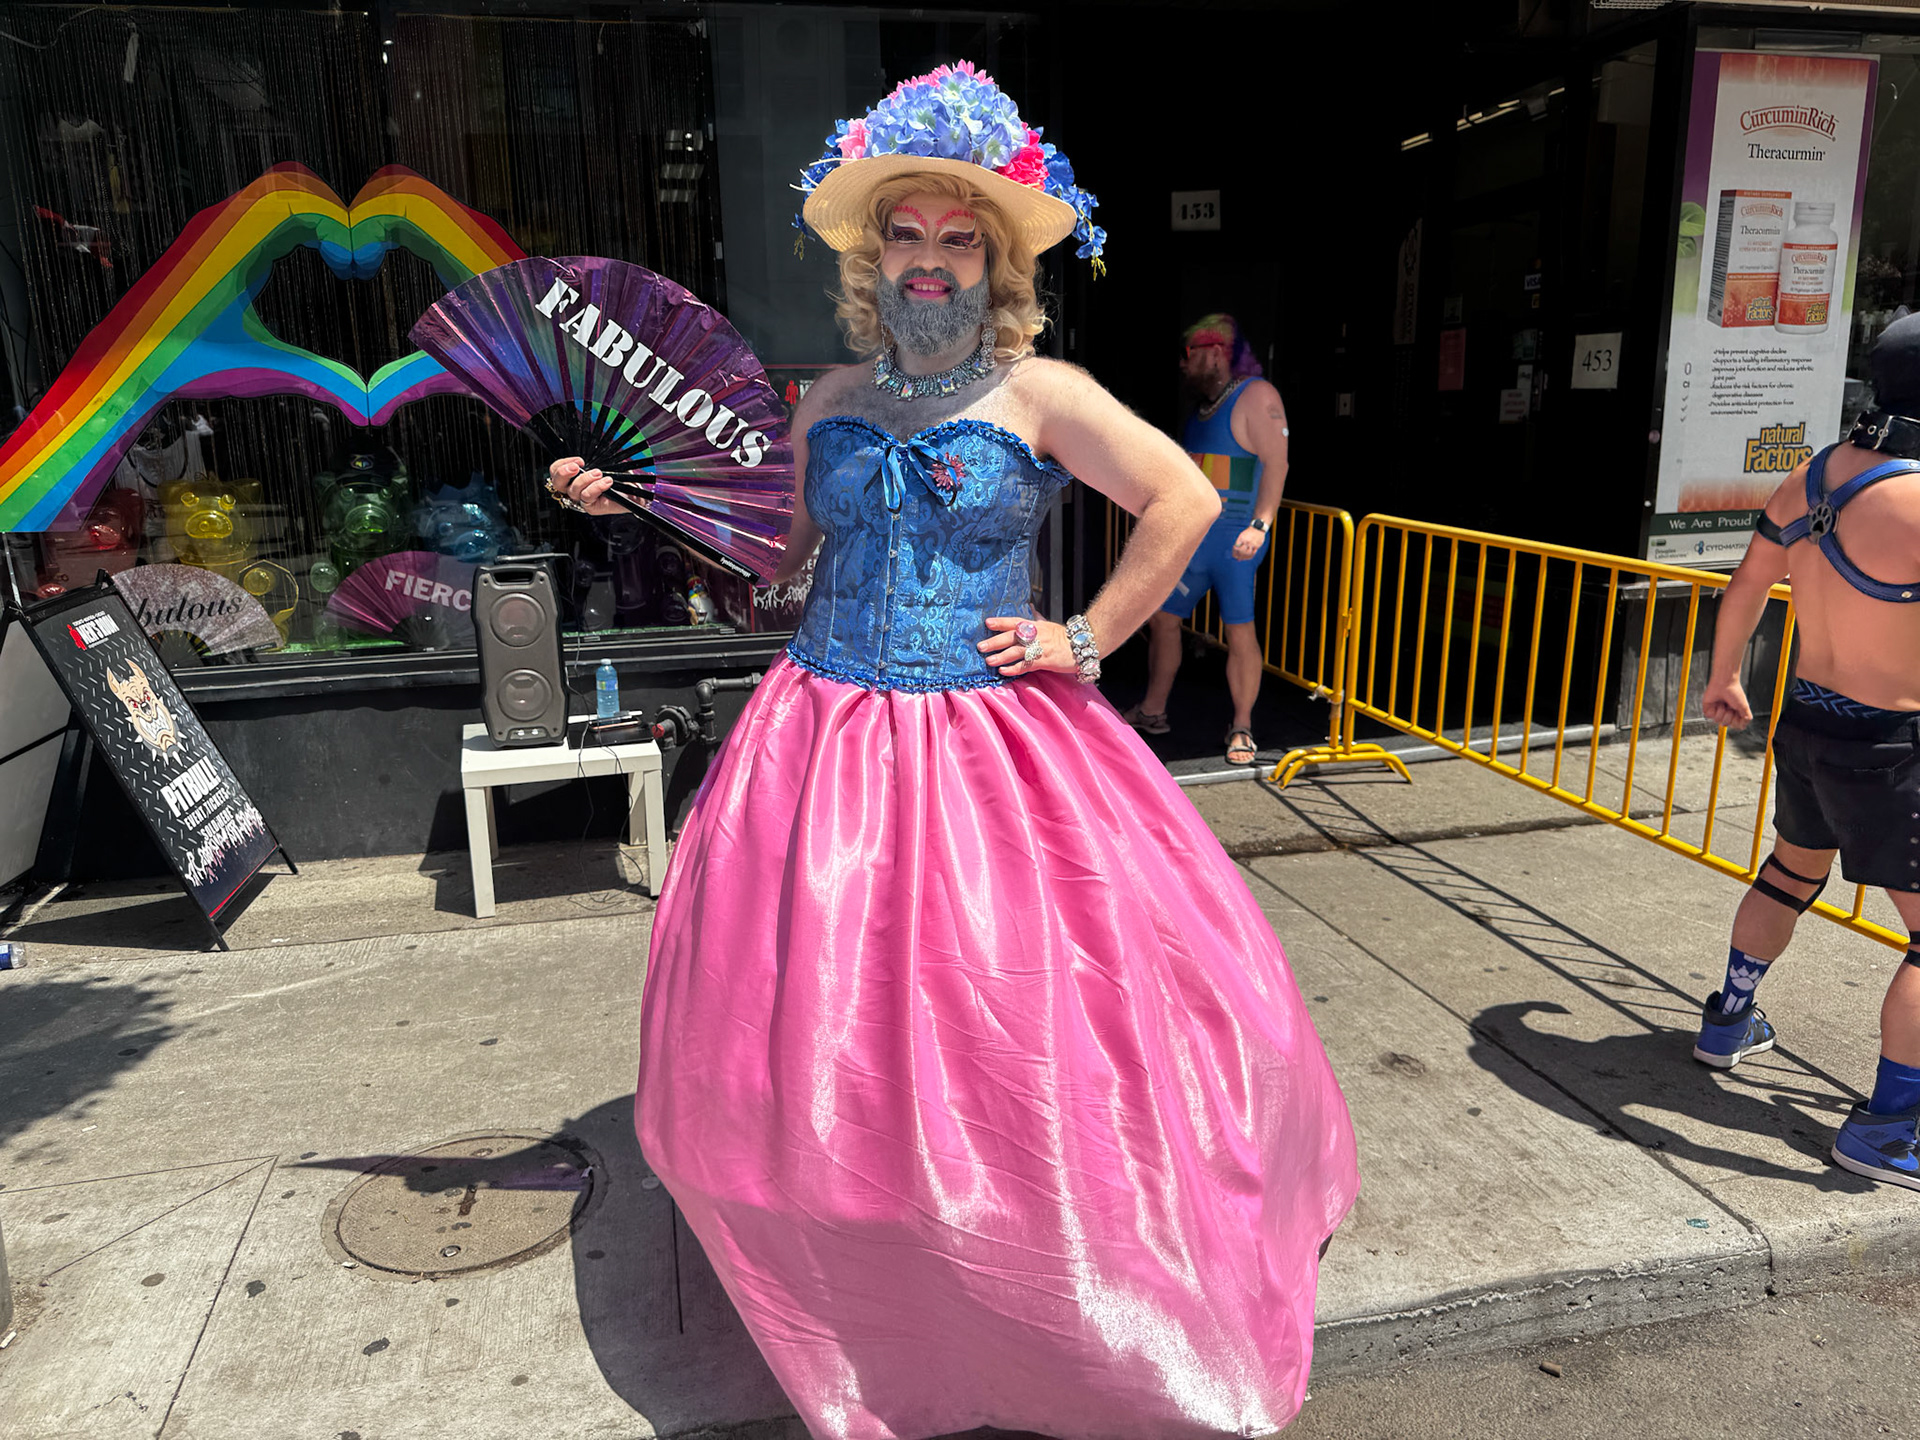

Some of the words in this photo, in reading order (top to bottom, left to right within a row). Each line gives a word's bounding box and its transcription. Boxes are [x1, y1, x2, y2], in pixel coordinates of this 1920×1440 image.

[1740, 105, 1836, 136] CurcuminRich
[1748, 143, 1823, 161] Theracurmin
[1176, 202, 1215, 220] 453
[535, 277, 772, 468] FABULOUS
[1582, 349, 1612, 372] 453
[1761, 422, 1805, 445] natural
[1744, 439, 1813, 473] Factors
[1669, 519, 1686, 530] We
[1691, 518, 1712, 528] Are
[1717, 512, 1752, 527] Proud
[385, 569, 472, 611] FIERC
[184, 806, 207, 831] EVENT
[203, 787, 230, 817] TICKETS
[200, 816, 222, 841] SOLD
[217, 805, 234, 830] HERE
